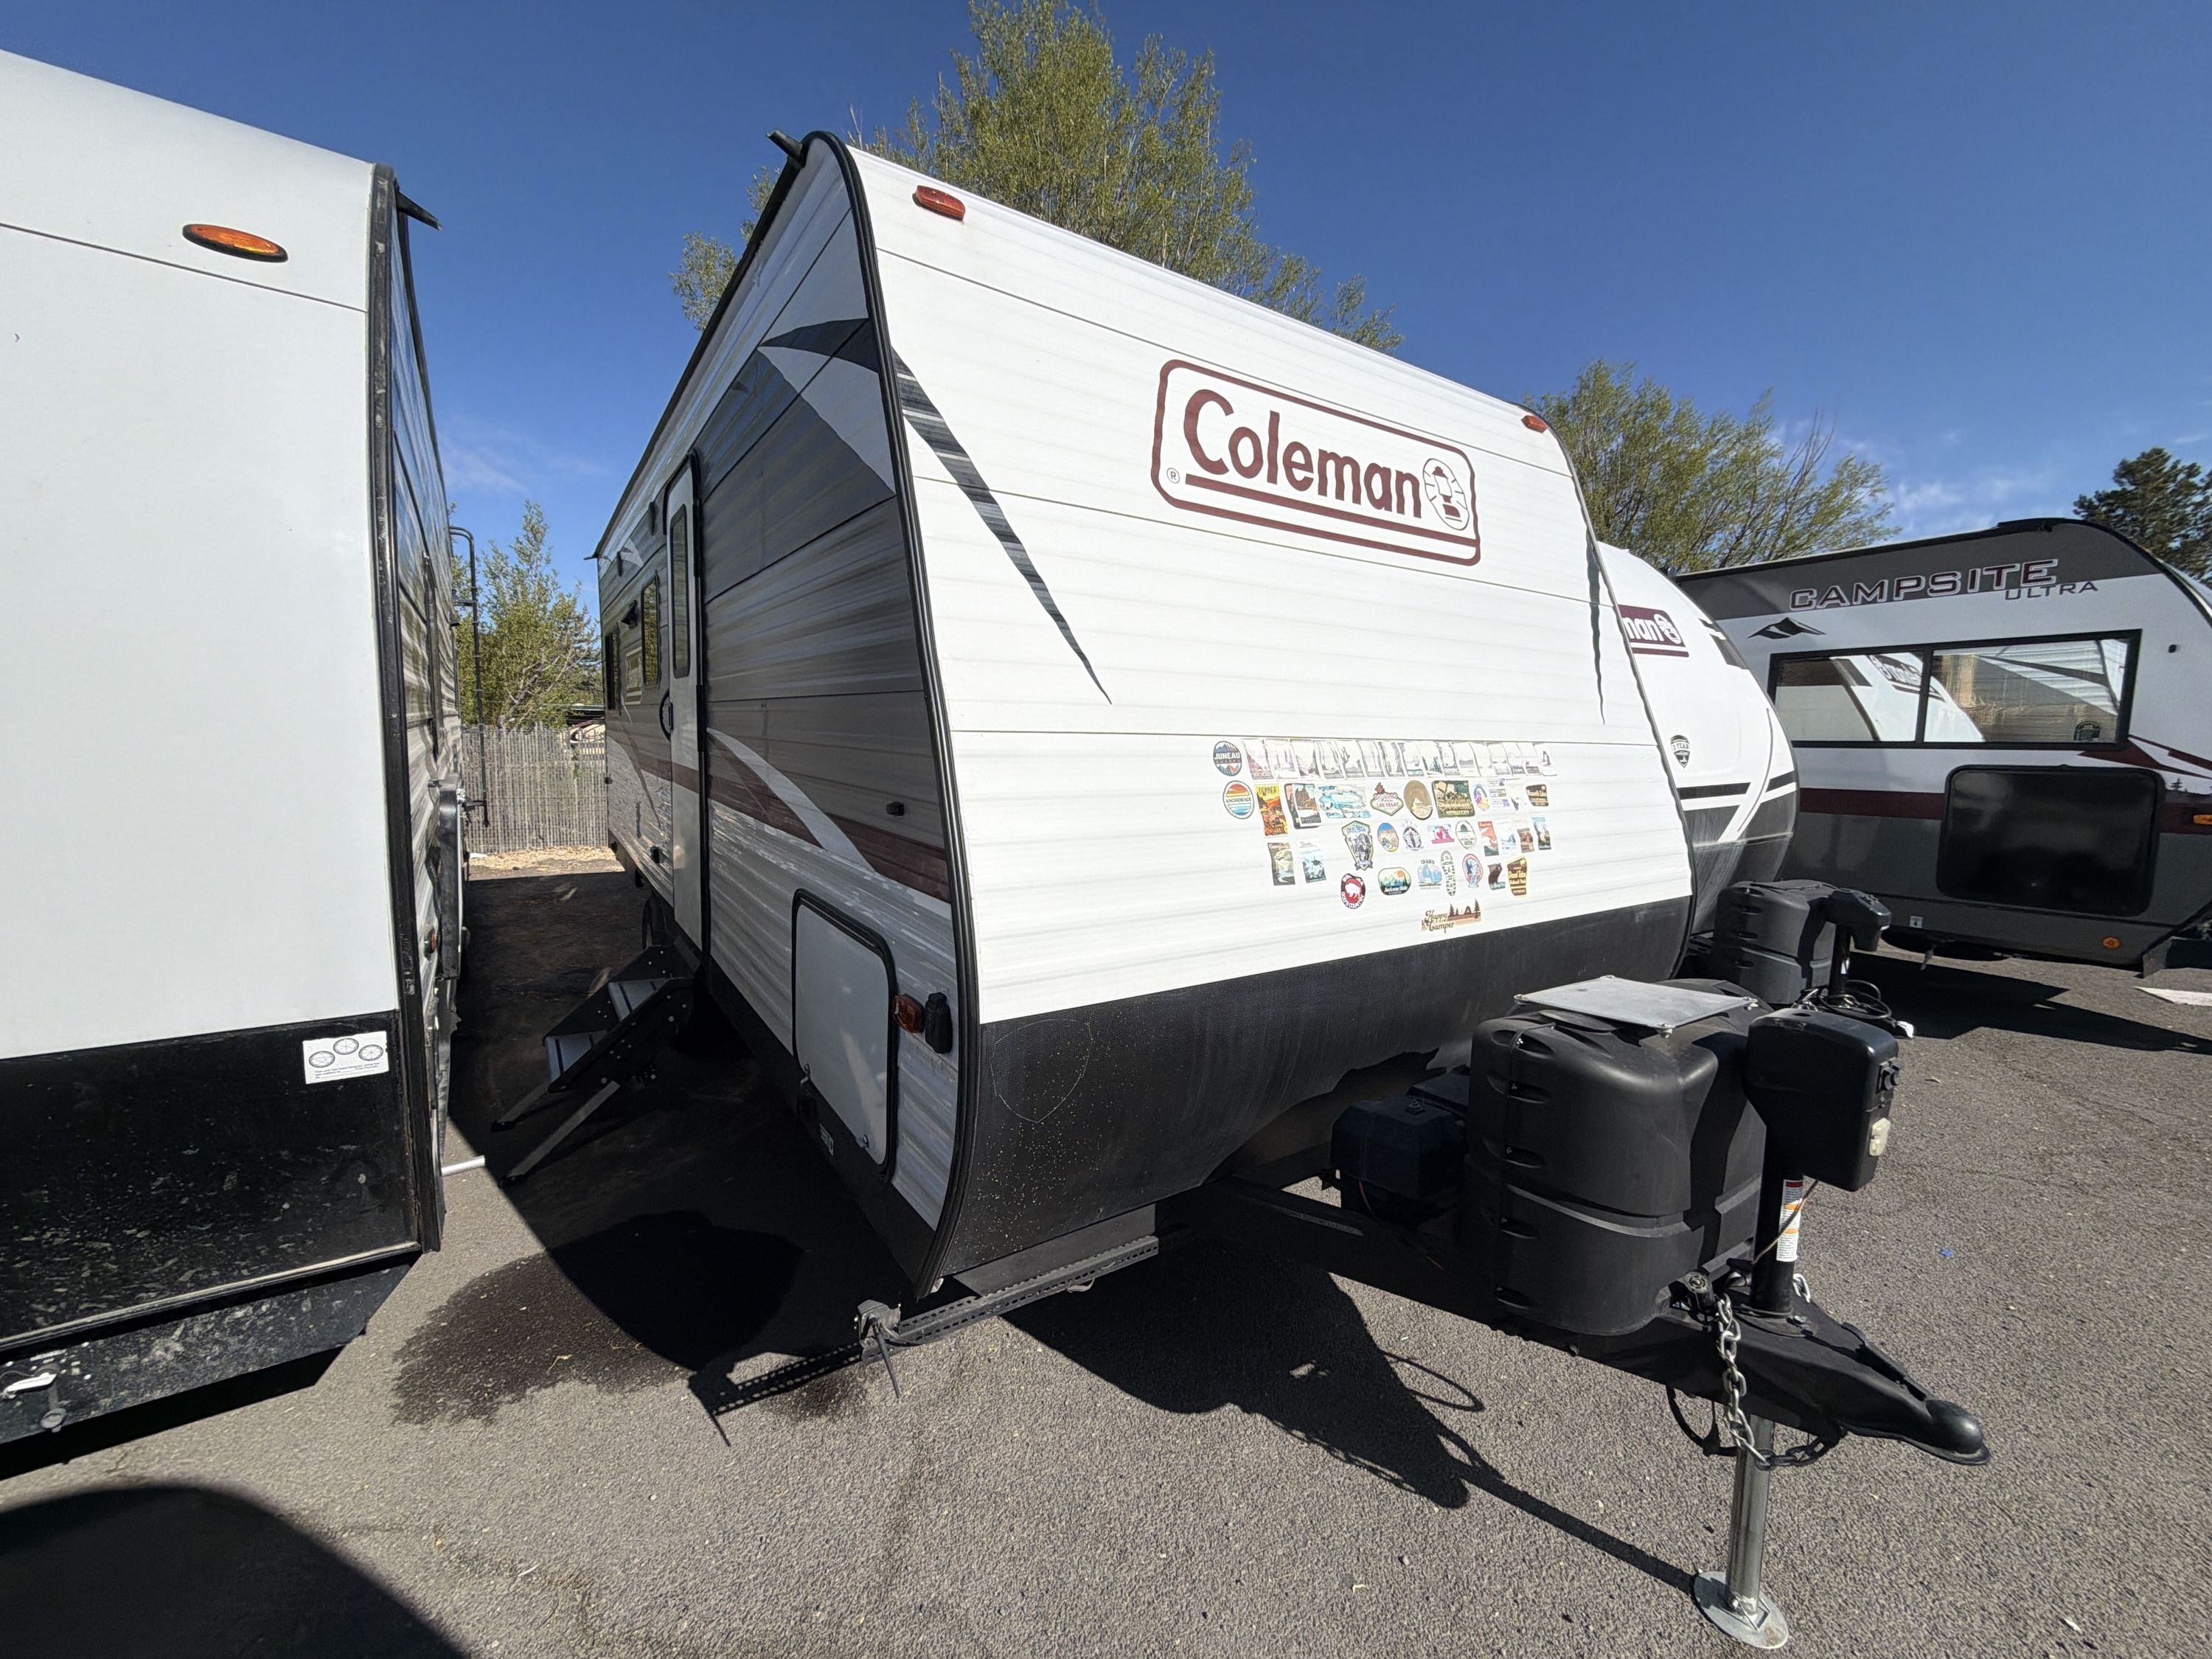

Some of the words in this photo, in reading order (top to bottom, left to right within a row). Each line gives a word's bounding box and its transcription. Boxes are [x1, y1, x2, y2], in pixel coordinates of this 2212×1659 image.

[1183, 389, 1422, 518] Coleman
[1790, 559, 2058, 611] CAMPSITE
[2004, 581, 2098, 601] ULTRA
[1214, 752, 1240, 760] JUNEAU
[1425, 909, 1447, 923] Happy
[1429, 922, 1455, 933] Camper
